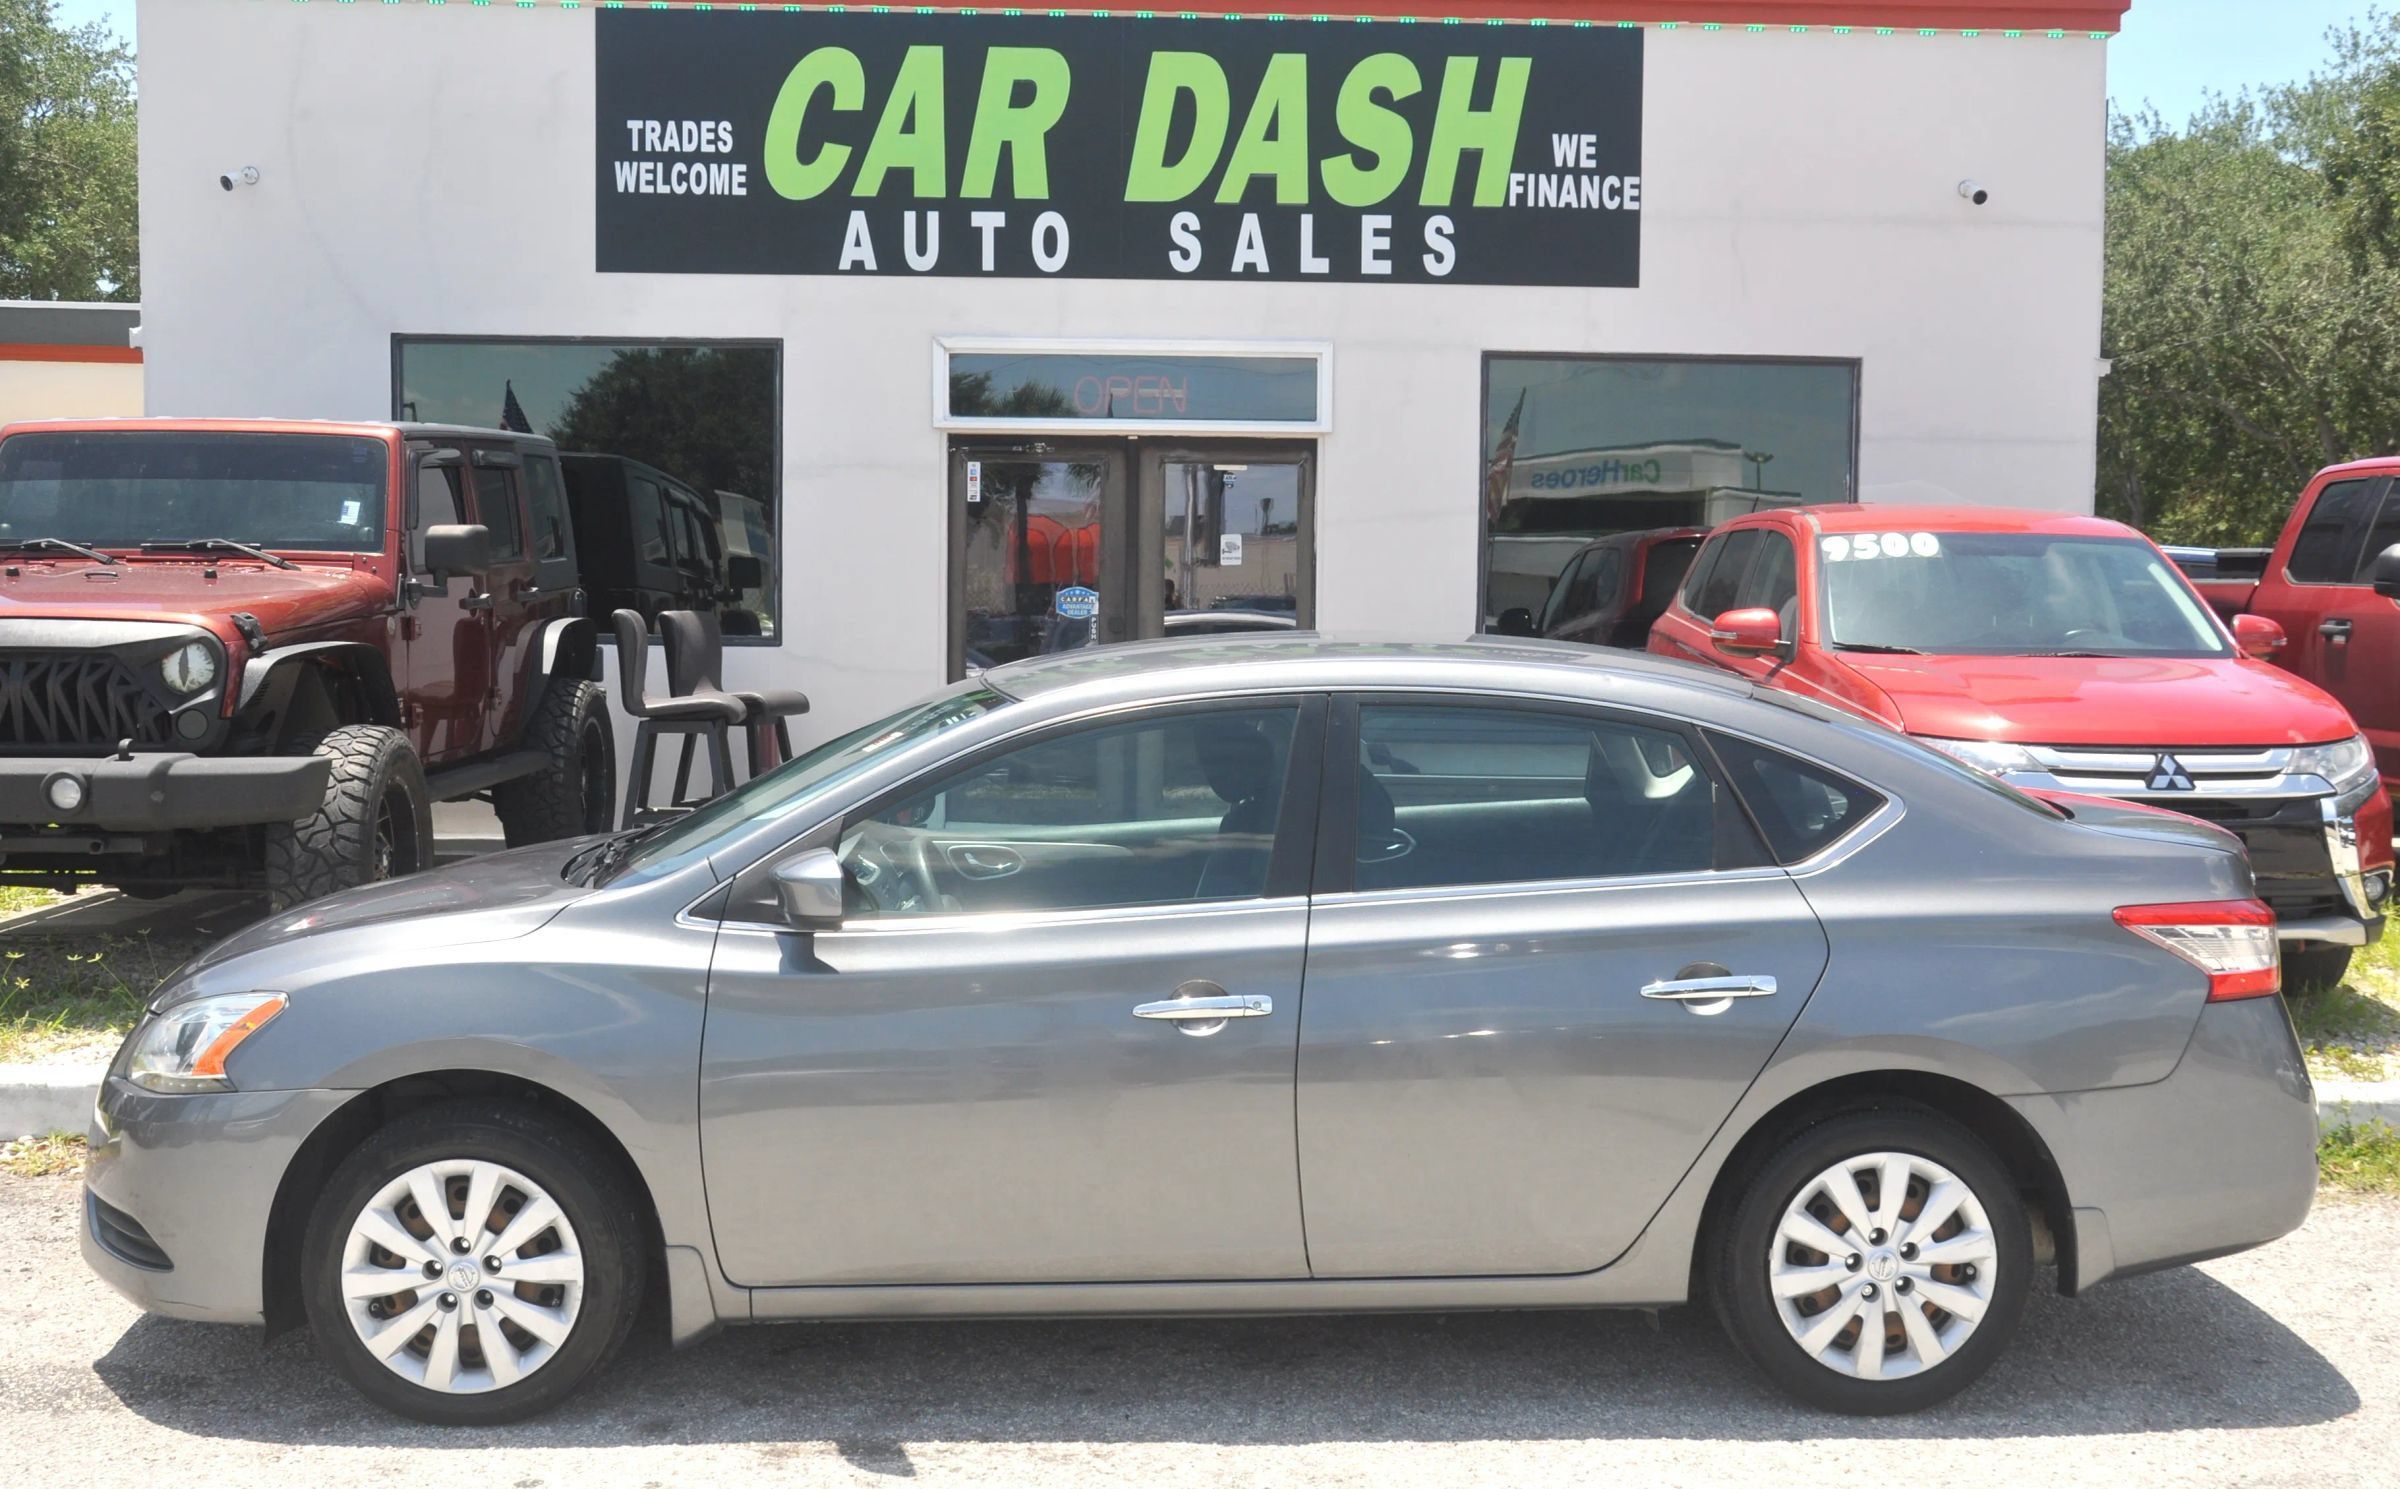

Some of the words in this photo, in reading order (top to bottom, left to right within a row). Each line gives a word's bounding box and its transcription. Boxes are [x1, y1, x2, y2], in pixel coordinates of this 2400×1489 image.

[627, 120, 733, 153] TRADES
[764, 45, 1071, 200] CAR
[1123, 51, 1532, 207] DASH
[1552, 134, 1597, 168] WE
[614, 161, 747, 196] WELCOME
[1509, 173, 1640, 210] FINANCE
[838, 210, 1070, 272] AUTO
[1168, 211, 1456, 276] SALES
[1074, 375, 1188, 413] OPEN
[1821, 532, 1940, 561] 9500
